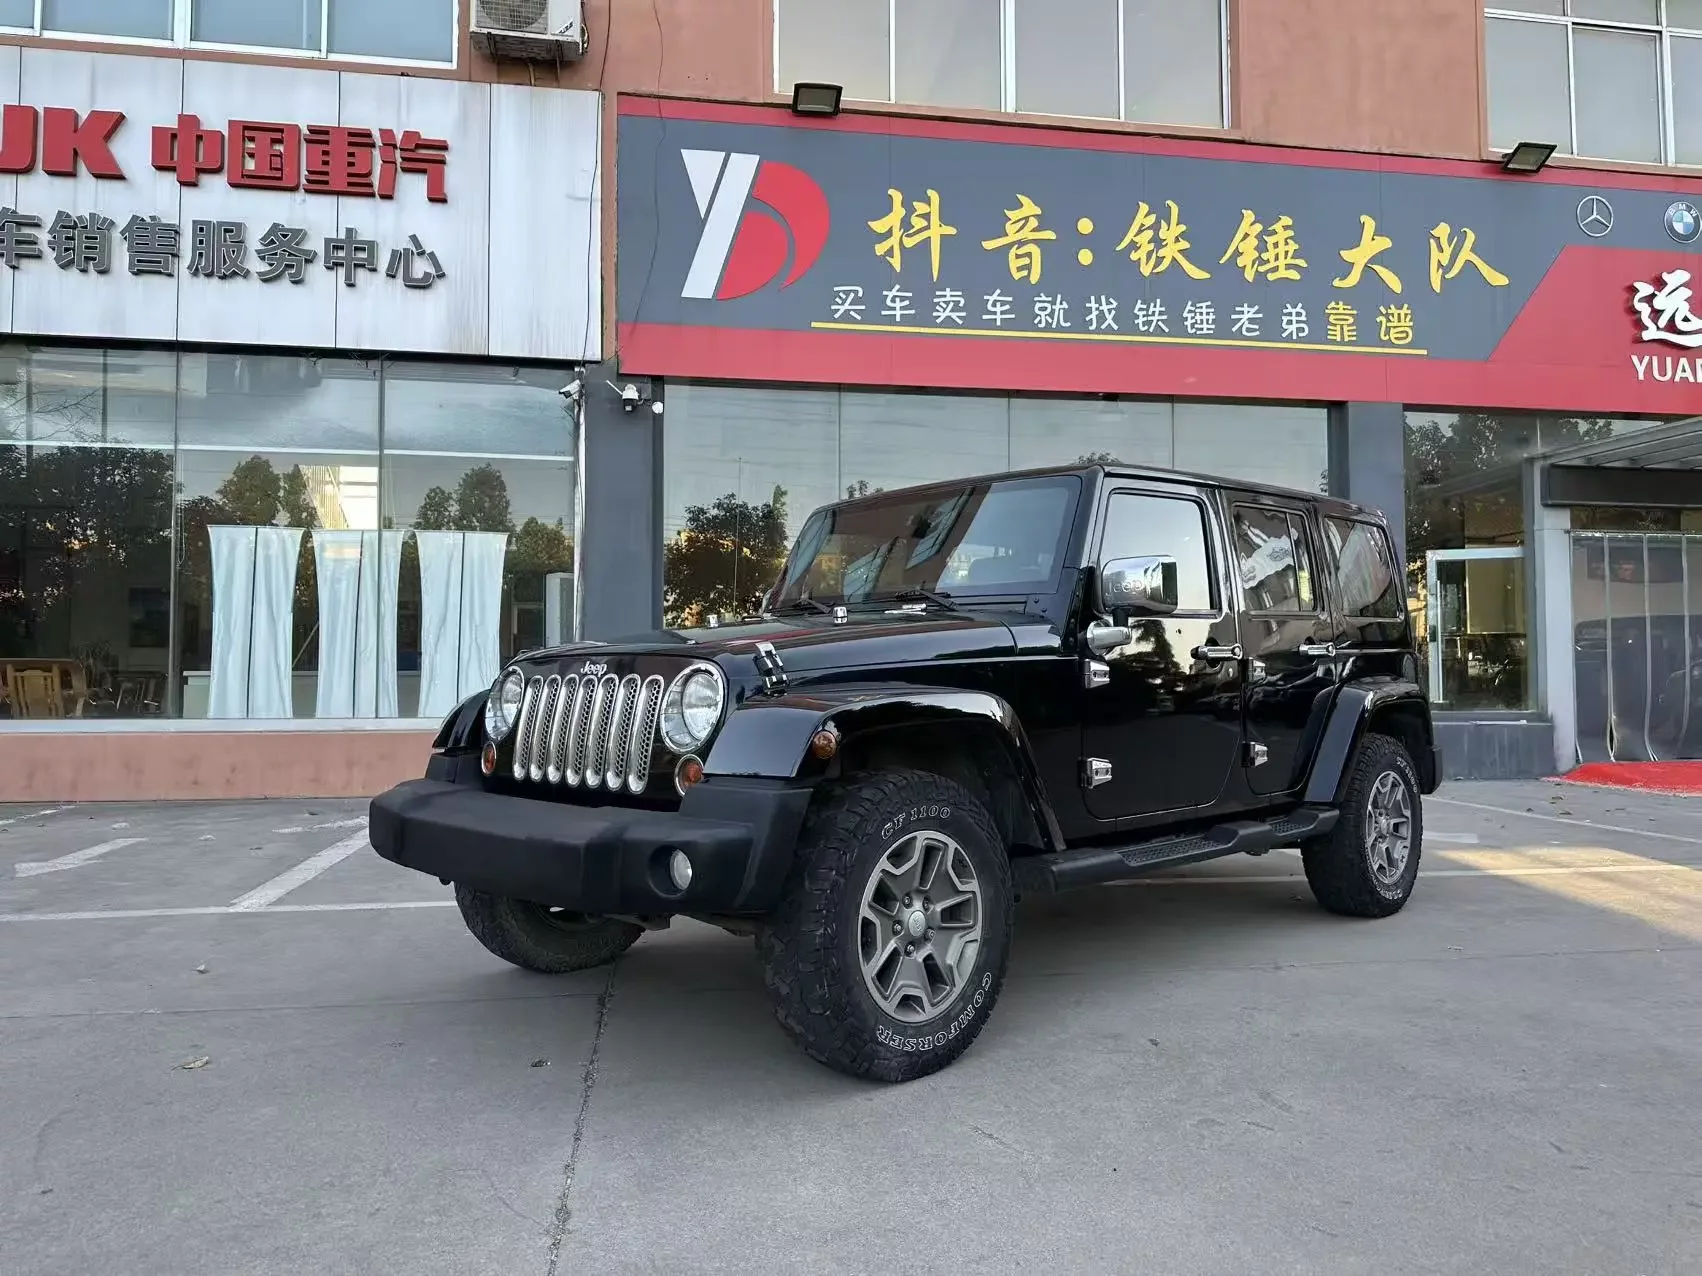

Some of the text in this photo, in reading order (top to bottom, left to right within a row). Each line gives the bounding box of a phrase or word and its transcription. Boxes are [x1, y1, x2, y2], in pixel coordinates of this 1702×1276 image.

[151, 114, 449, 203] 中国重汽
[580, 660, 608, 678] Jeep
[881, 804, 951, 840] CF 1100
[877, 972, 992, 1052] COMFORSER
